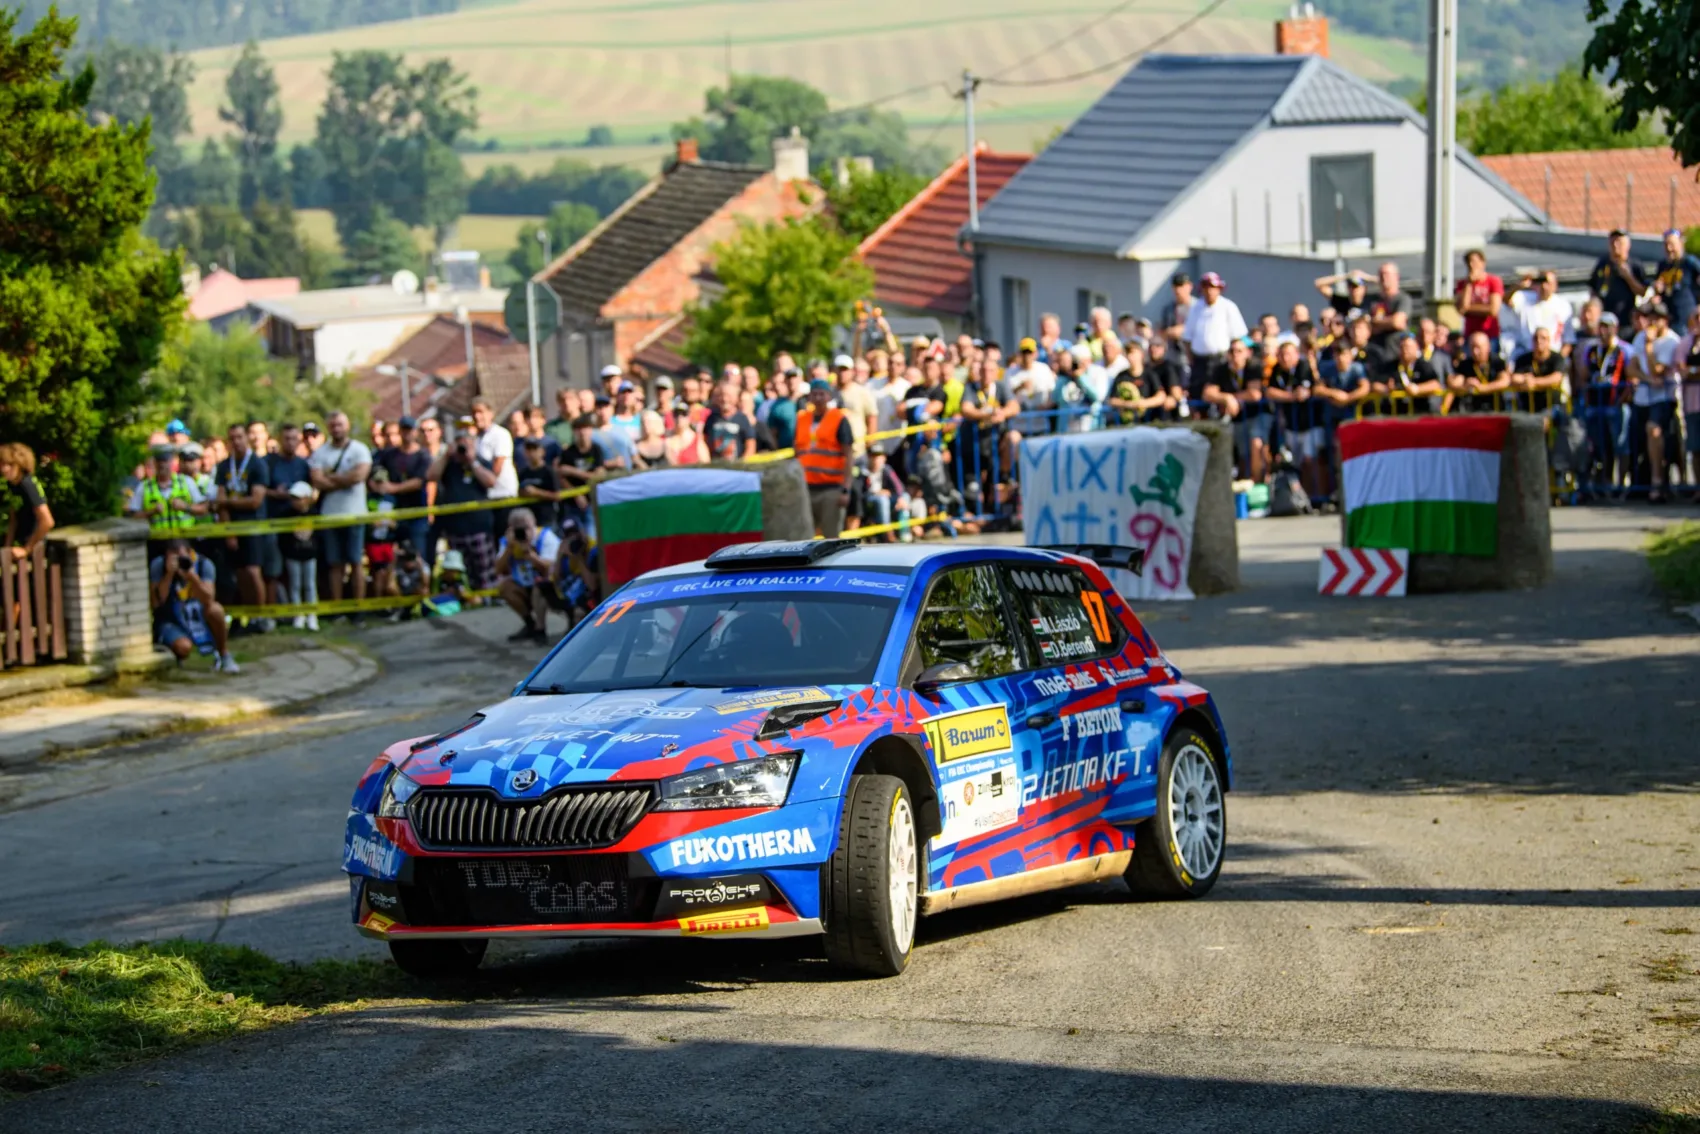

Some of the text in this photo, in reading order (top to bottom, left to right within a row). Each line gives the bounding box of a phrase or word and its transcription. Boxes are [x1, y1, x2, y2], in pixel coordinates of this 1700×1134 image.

[1129, 513, 1185, 590] 93
[672, 576, 826, 594] ERC LIVE ON RALLY.TV
[1080, 590, 1112, 643] 17
[946, 725, 995, 747] Barum
[1075, 706, 1123, 738] BETON
[1040, 755, 1098, 802] LETICIA
[669, 827, 817, 867] FUKOTHERM
[530, 881, 617, 913] CARS
[687, 913, 760, 932] PIRELLI
